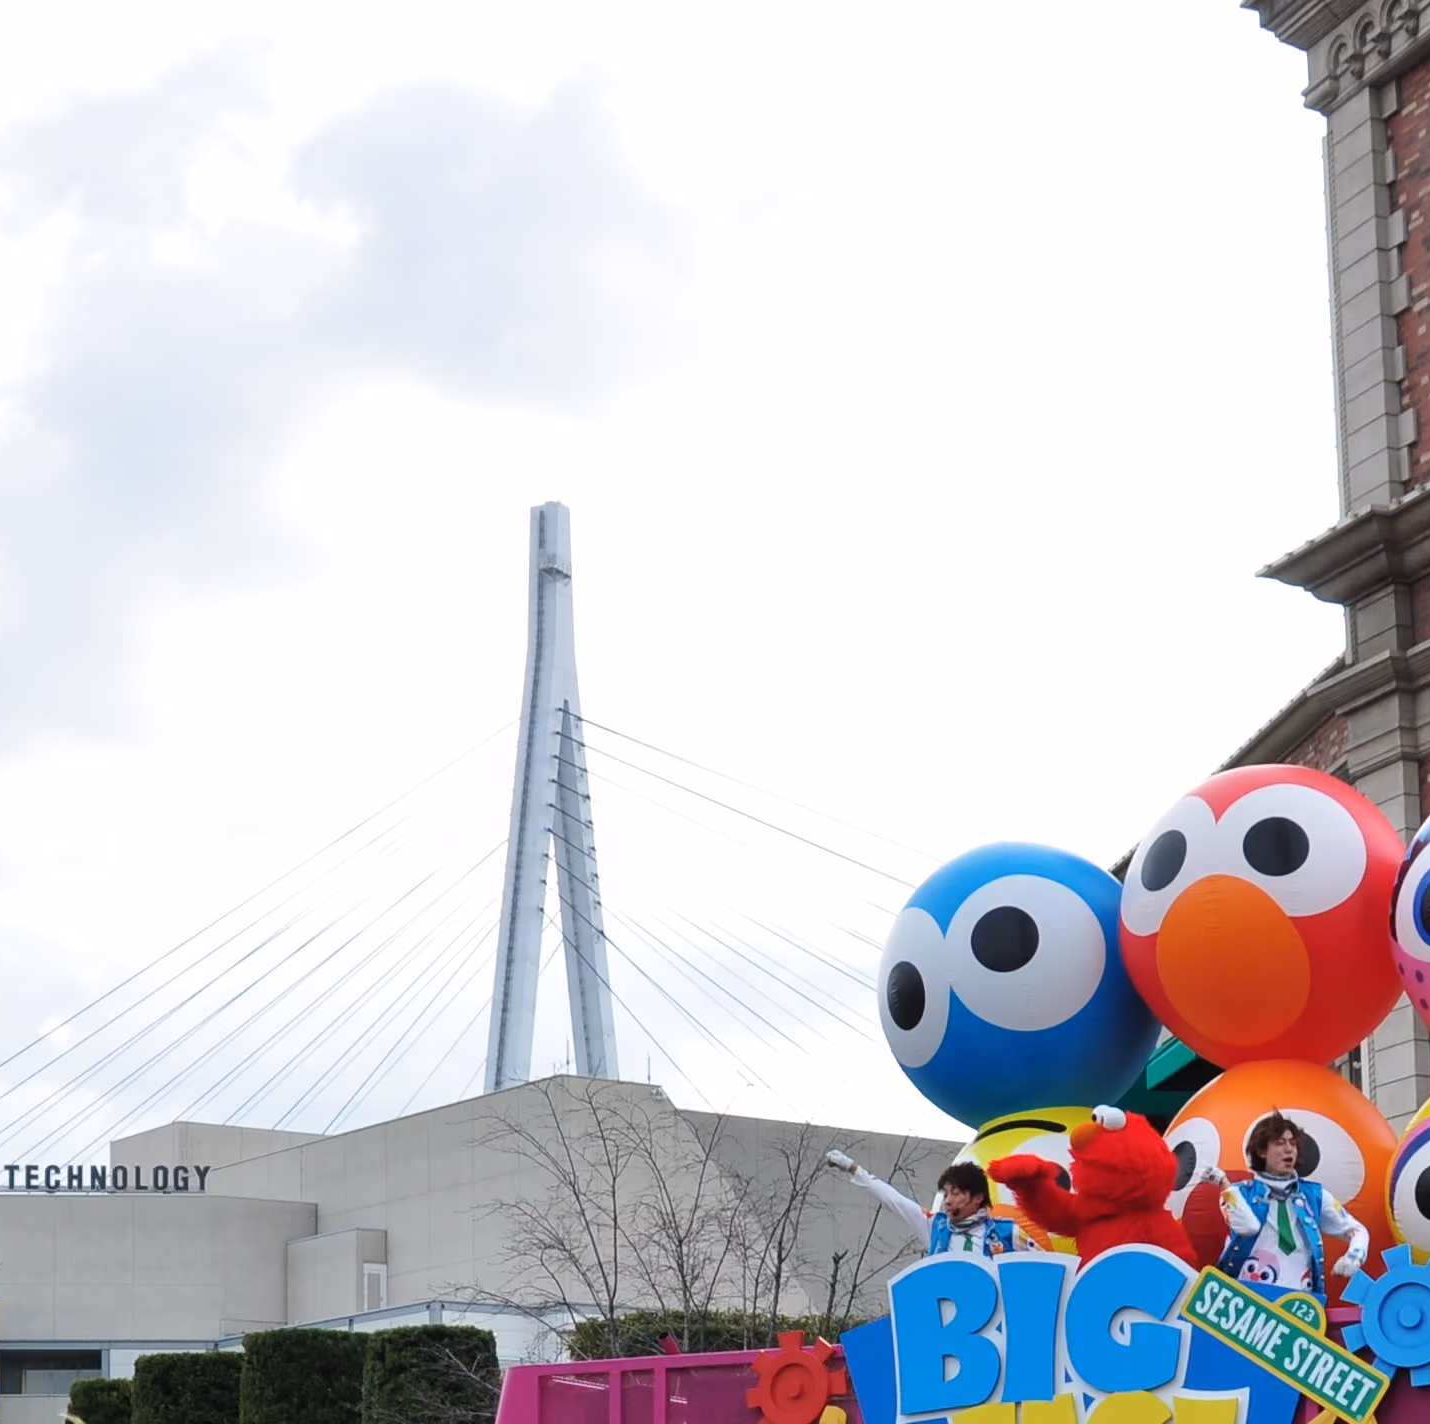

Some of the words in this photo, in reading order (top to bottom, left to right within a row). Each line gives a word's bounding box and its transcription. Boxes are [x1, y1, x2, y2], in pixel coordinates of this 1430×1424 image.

[4, 1162, 212, 1193] TECHNOLOGY
[889, 1244, 1191, 1415] BIG
[1195, 1281, 1291, 1361] SESAME
[1284, 1336, 1377, 1412] STREET
[1291, 1301, 1316, 1323] 123
